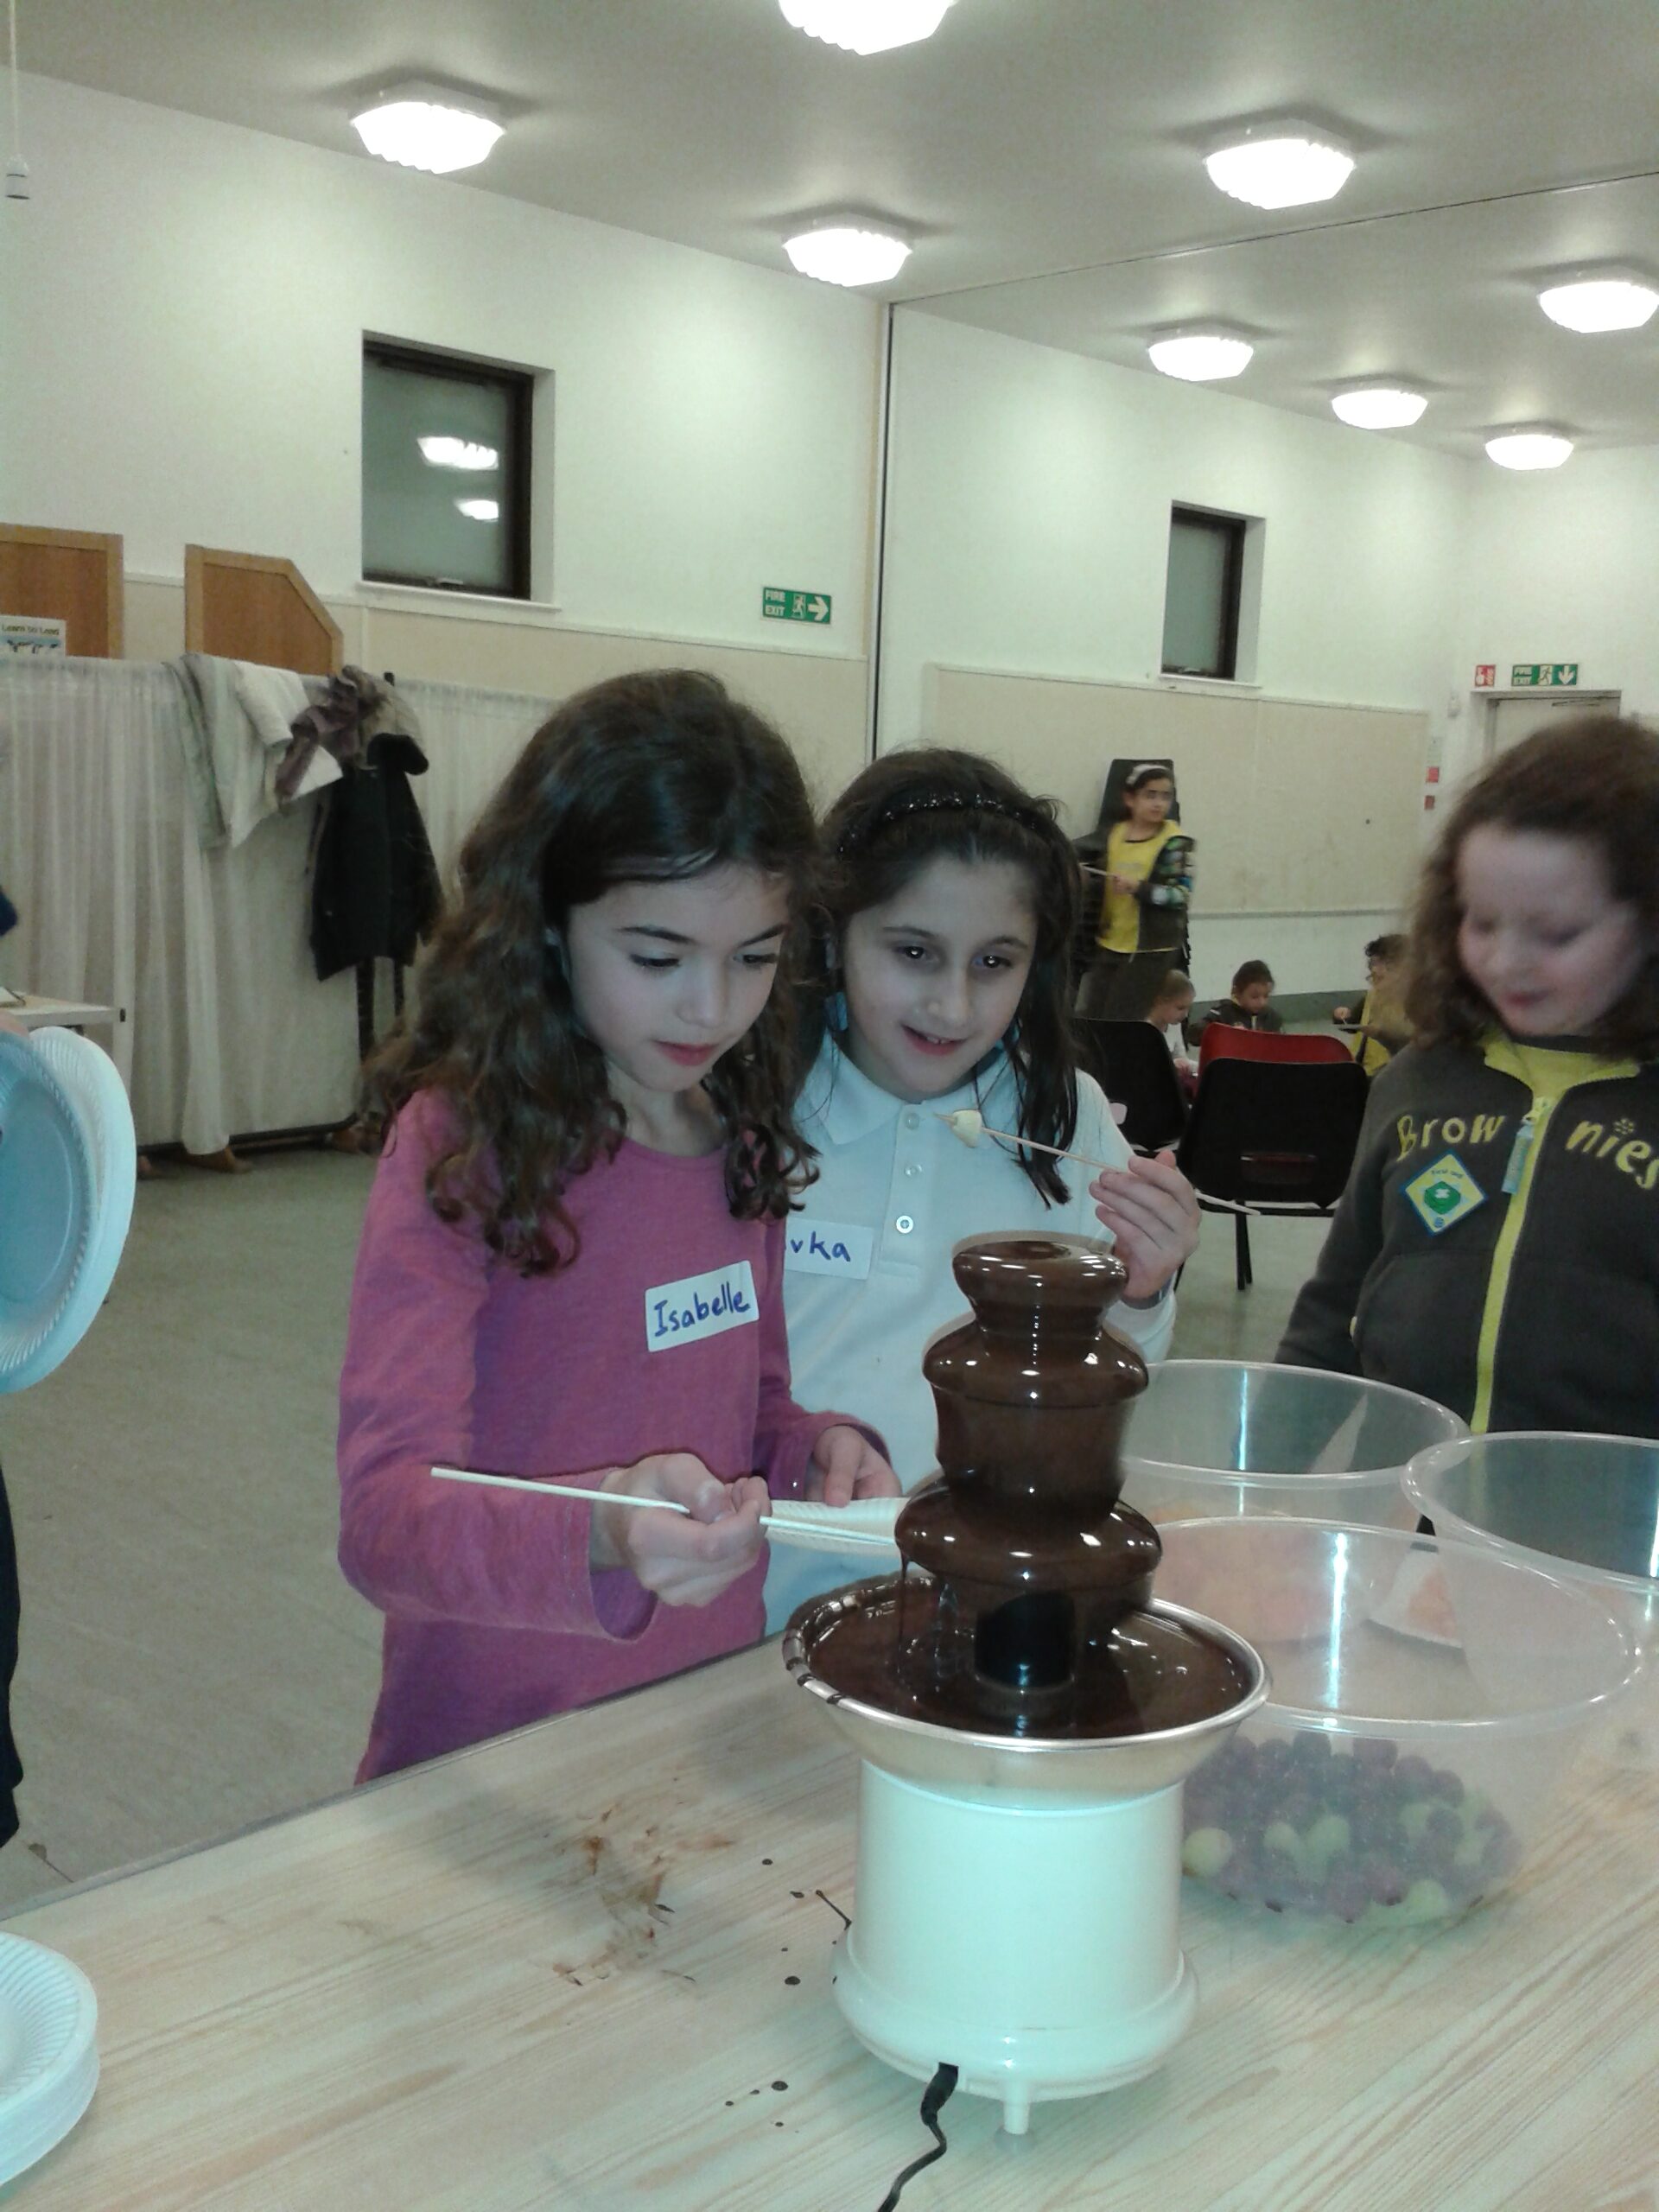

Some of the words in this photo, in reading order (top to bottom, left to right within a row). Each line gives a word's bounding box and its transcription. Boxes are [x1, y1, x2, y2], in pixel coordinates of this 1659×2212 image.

[765, 589, 785, 602] FIRE
[765, 604, 785, 616] EXIT
[785, 1230, 851, 1262] vka
[653, 1281, 751, 1338] Isabelle
